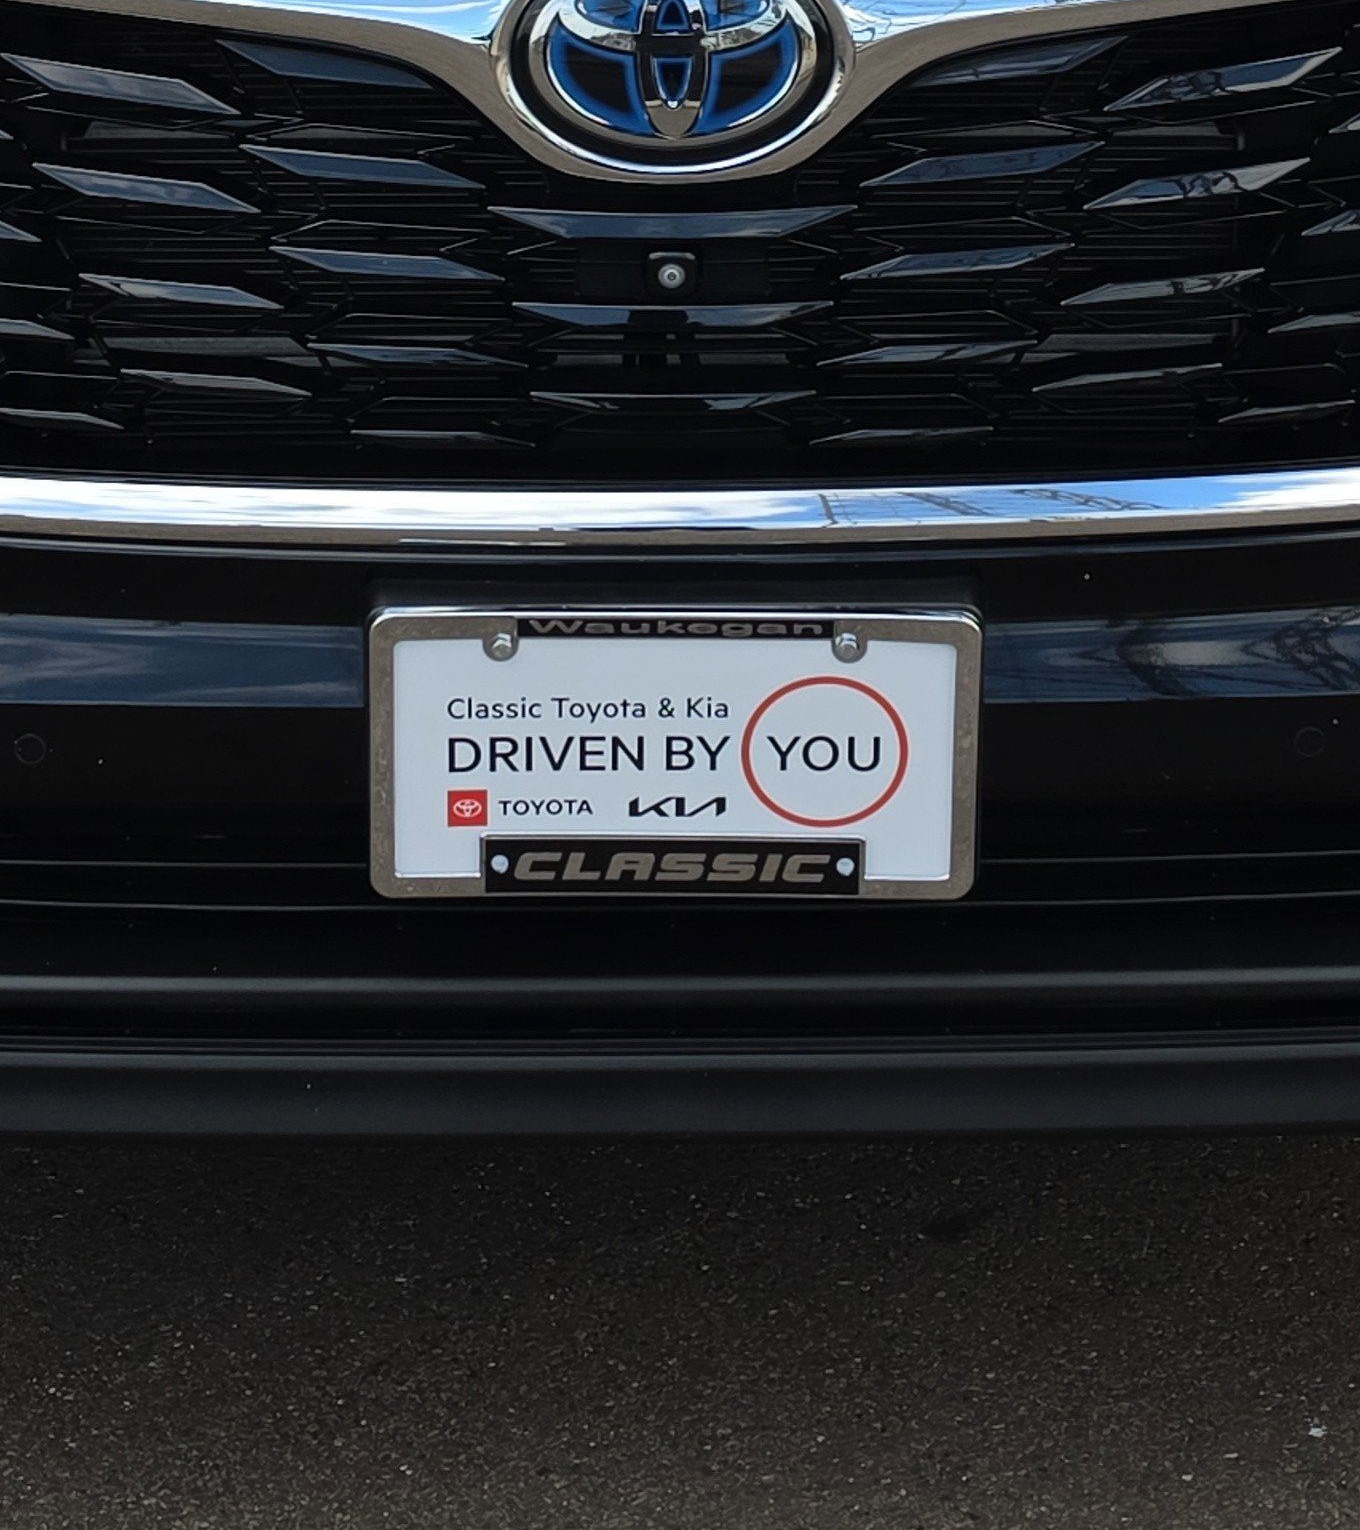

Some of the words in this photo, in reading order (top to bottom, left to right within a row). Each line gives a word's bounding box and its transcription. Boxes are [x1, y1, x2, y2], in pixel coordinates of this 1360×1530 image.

[447, 697, 542, 720] Classic
[551, 697, 646, 723] Toyota
[658, 698, 676, 719] &
[686, 697, 730, 720] Kia
[447, 736, 645, 773] DRIVEN
[665, 735, 731, 772] BY
[767, 735, 882, 772] YOU
[498, 798, 594, 817] TOYOTA
[513, 851, 832, 884] CLASSIC
